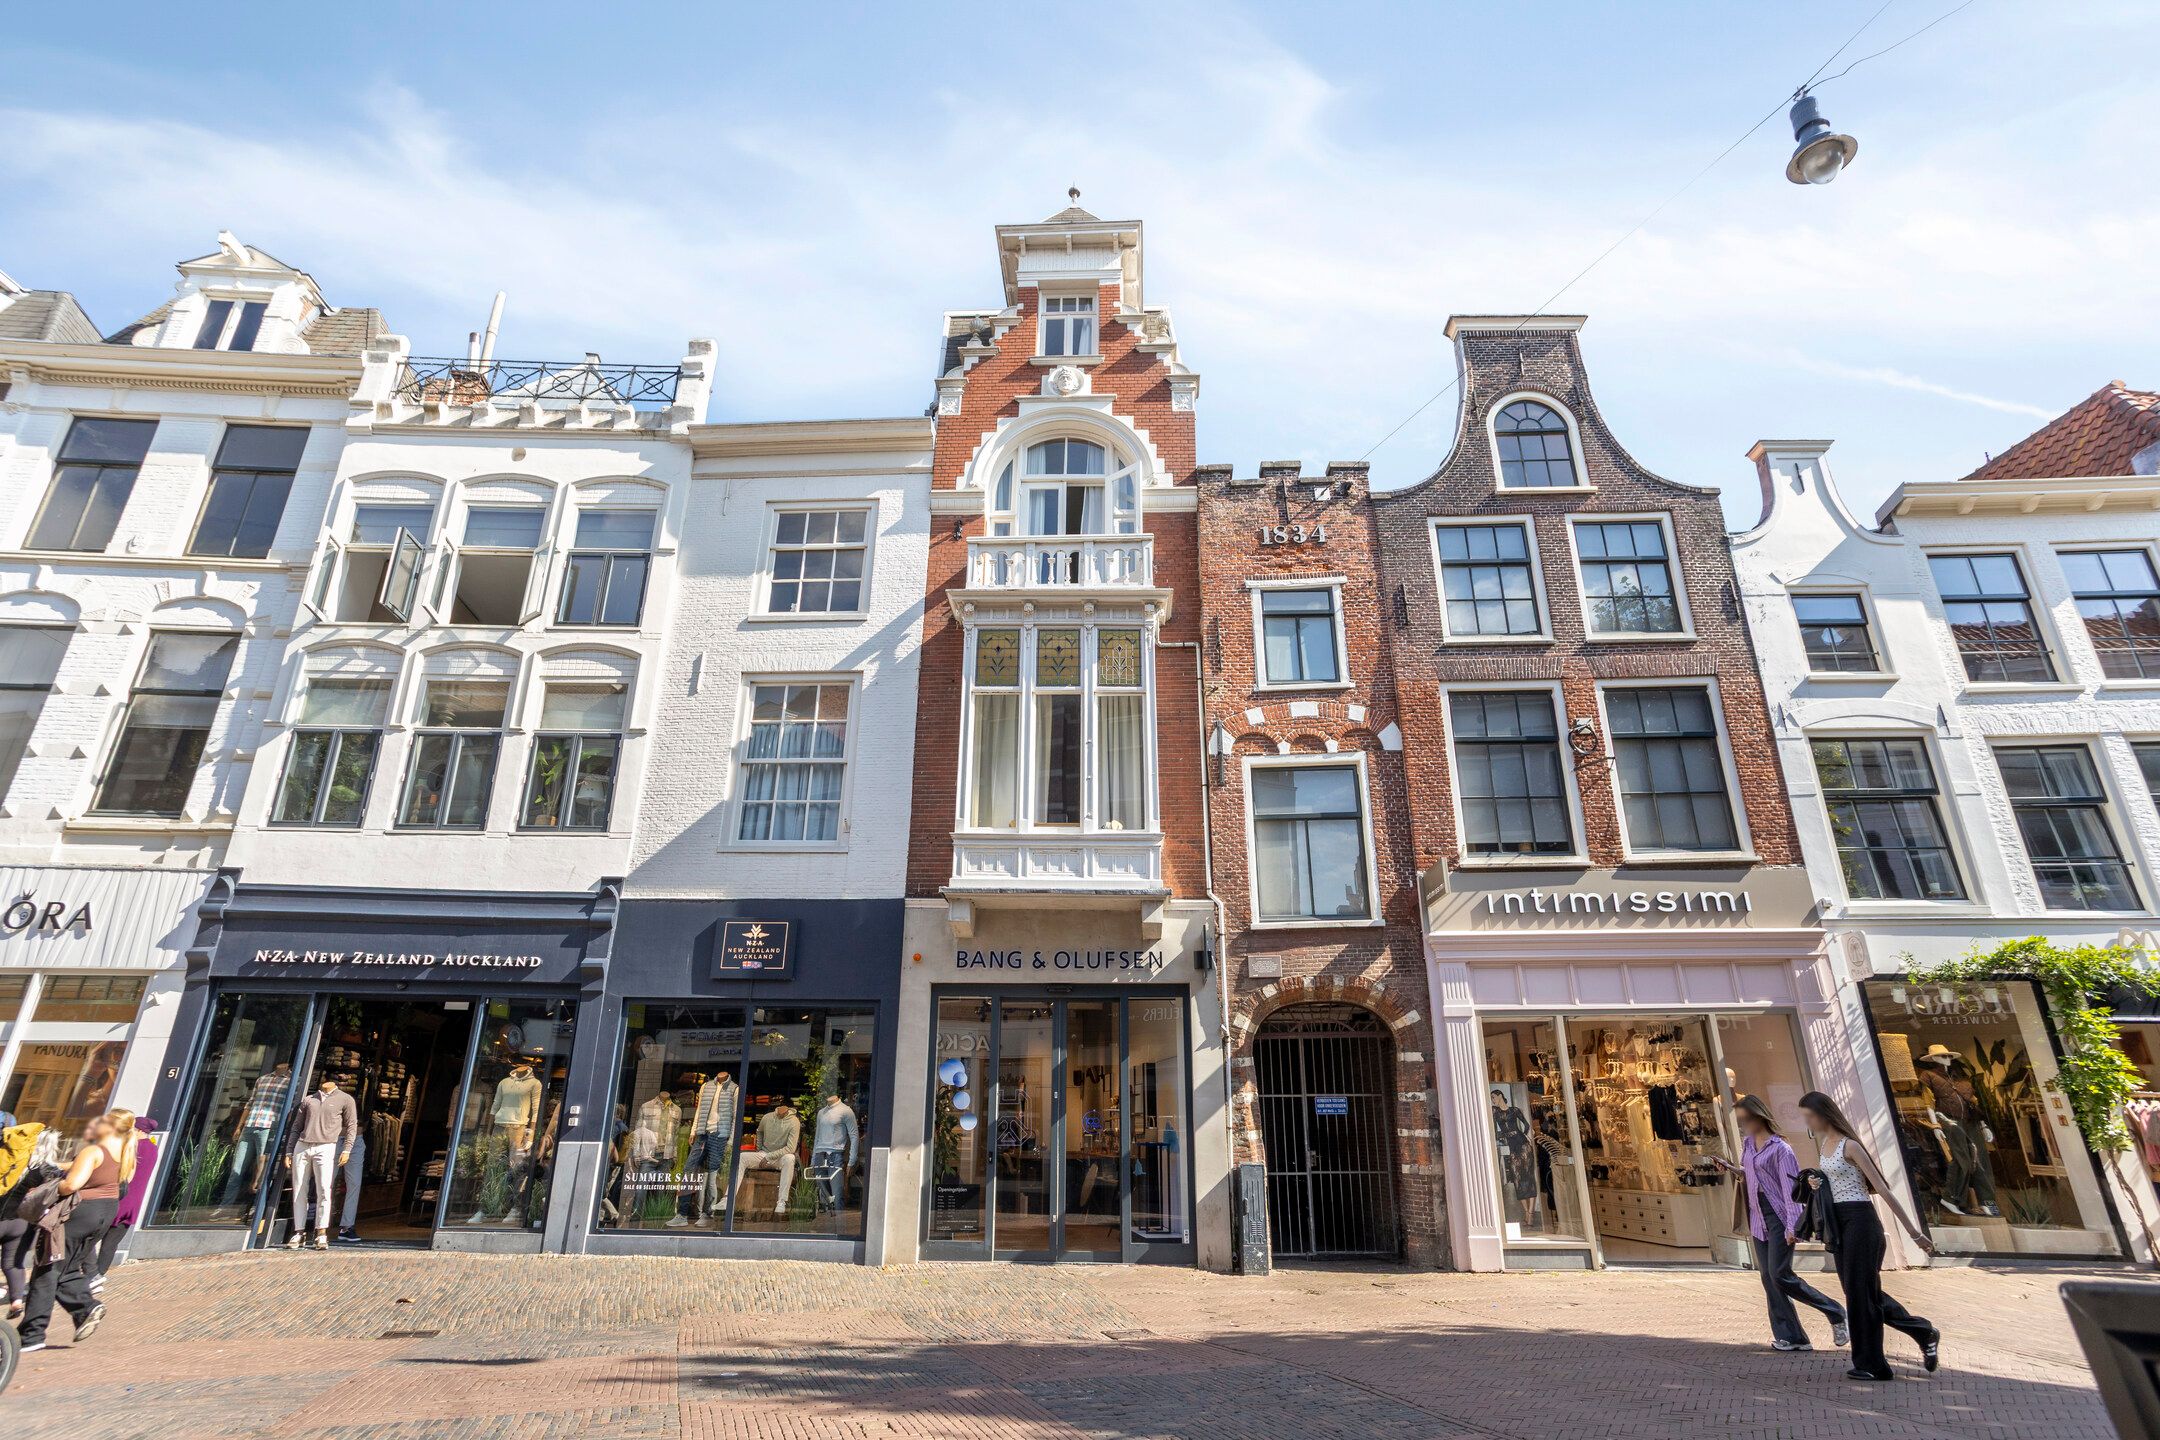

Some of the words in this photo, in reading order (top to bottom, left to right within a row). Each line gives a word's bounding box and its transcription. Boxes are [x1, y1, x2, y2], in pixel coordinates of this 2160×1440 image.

[1260, 524, 1328, 545] 1834
[1487, 888, 1752, 914] intimissimi
[303, 950, 345, 964] NEW
[351, 951, 435, 965] ZEALAND
[442, 953, 543, 967] AUCKLAND
[956, 950, 1022, 969] BANG
[1032, 950, 1047, 968] &
[1054, 950, 1164, 969] OLUFSEN
[34, 1045, 88, 1060] PANDORA
[167, 1069, 176, 1078] 5
[624, 1172, 672, 1183] SUMMER
[675, 1172, 705, 1183] SALE
